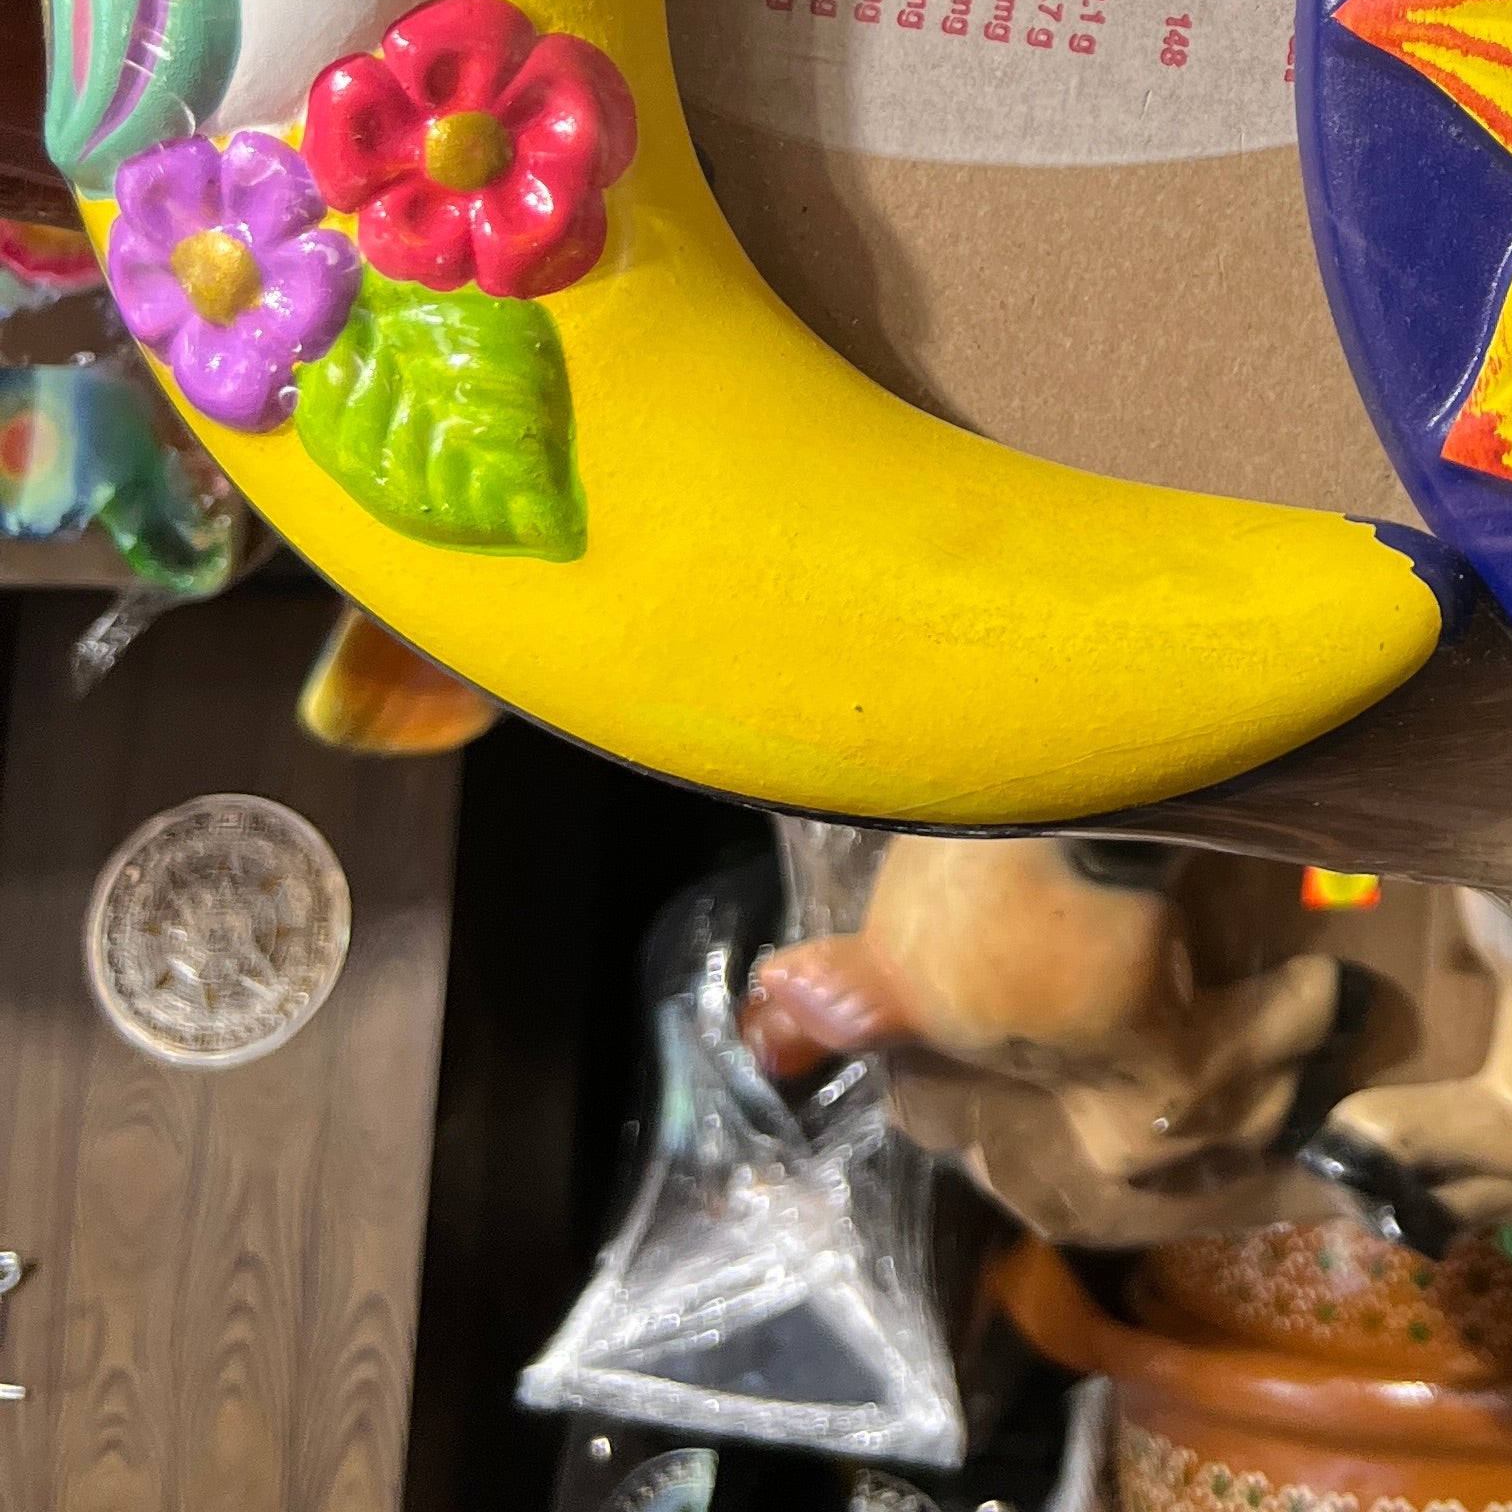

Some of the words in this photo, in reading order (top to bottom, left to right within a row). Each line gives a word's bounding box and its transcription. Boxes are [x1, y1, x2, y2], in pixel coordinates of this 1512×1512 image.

[1025, 28, 1054, 48] g
[1067, 33, 1096, 55] g
[1159, 13, 1191, 67] 148
